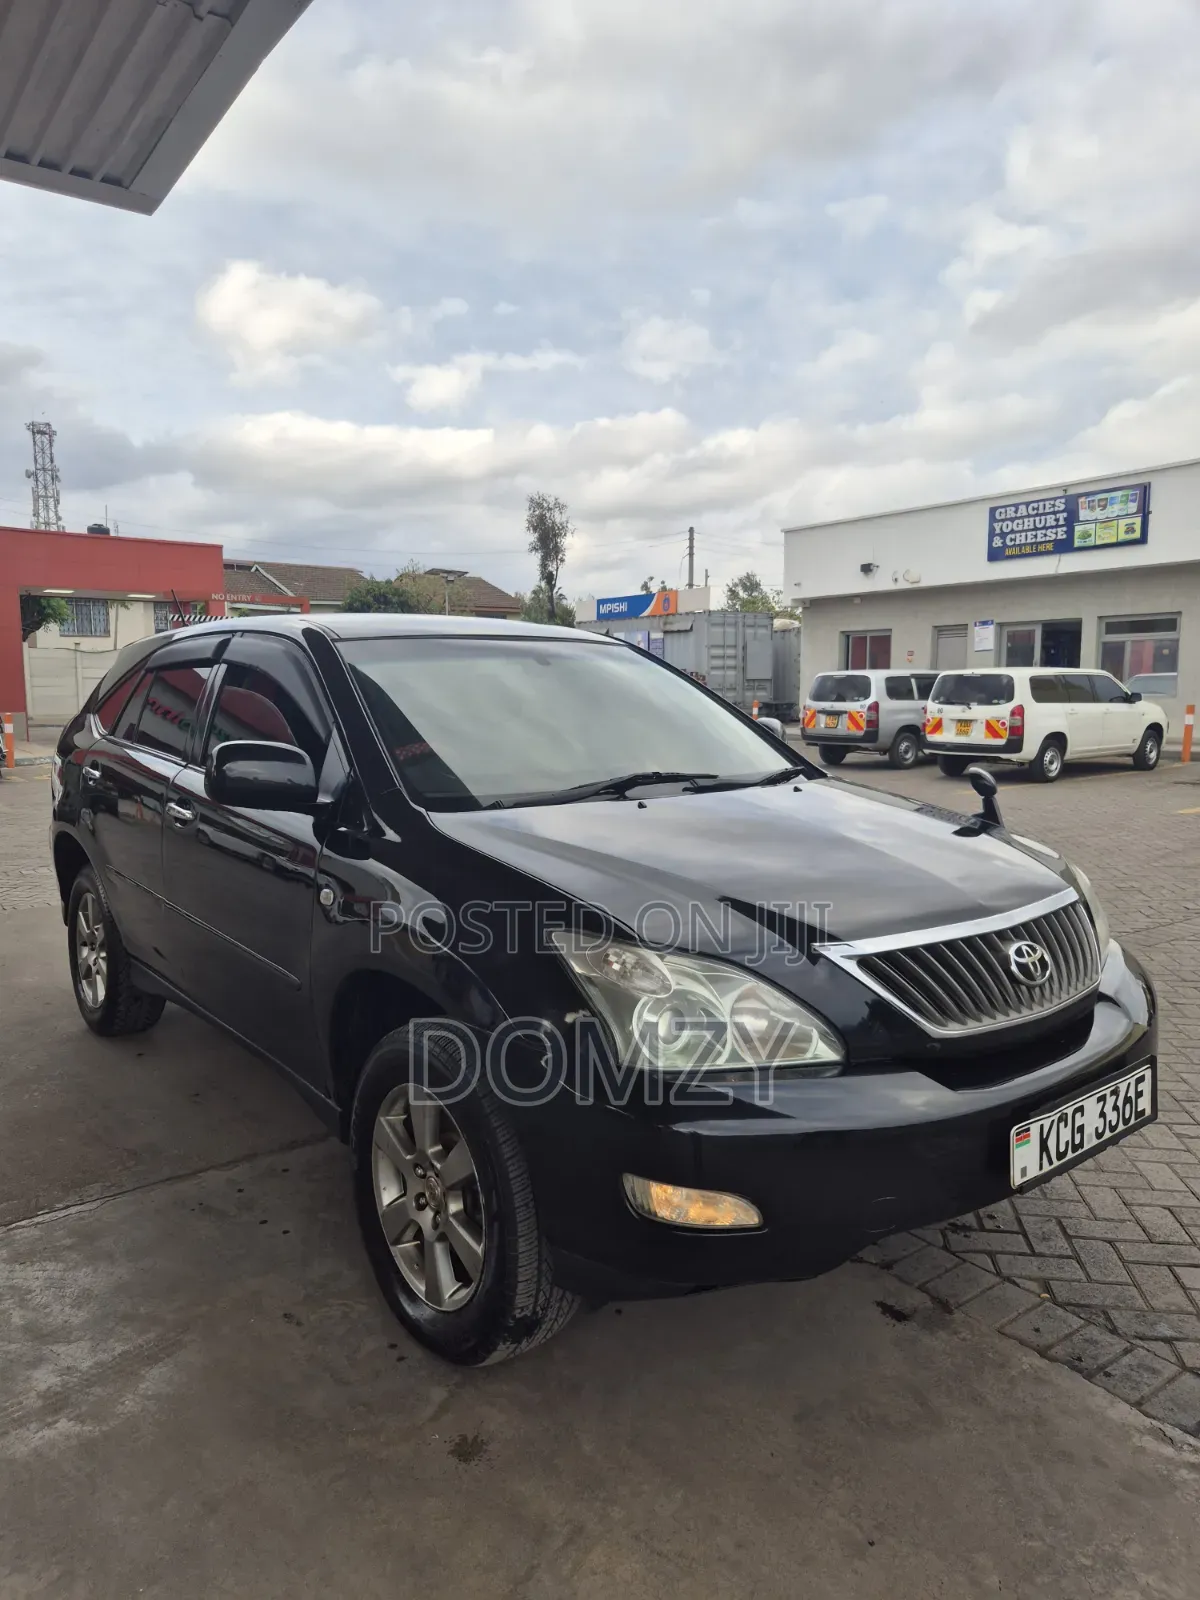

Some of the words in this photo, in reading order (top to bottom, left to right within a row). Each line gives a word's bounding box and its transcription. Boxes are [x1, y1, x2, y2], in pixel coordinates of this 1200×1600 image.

[995, 498, 1066, 519] GRACIES
[993, 512, 1067, 534] YOGHURT
[992, 534, 1003, 548] &
[1005, 527, 1067, 546] CHEESE
[1005, 544, 1037, 556] AVAILABLE
[1037, 542, 1054, 552] HERE
[226, 593, 252, 601] ENTRY
[600, 602, 628, 614] MPISHI
[1038, 1104, 1085, 1172] KCG
[1094, 1073, 1146, 1141] 336E
